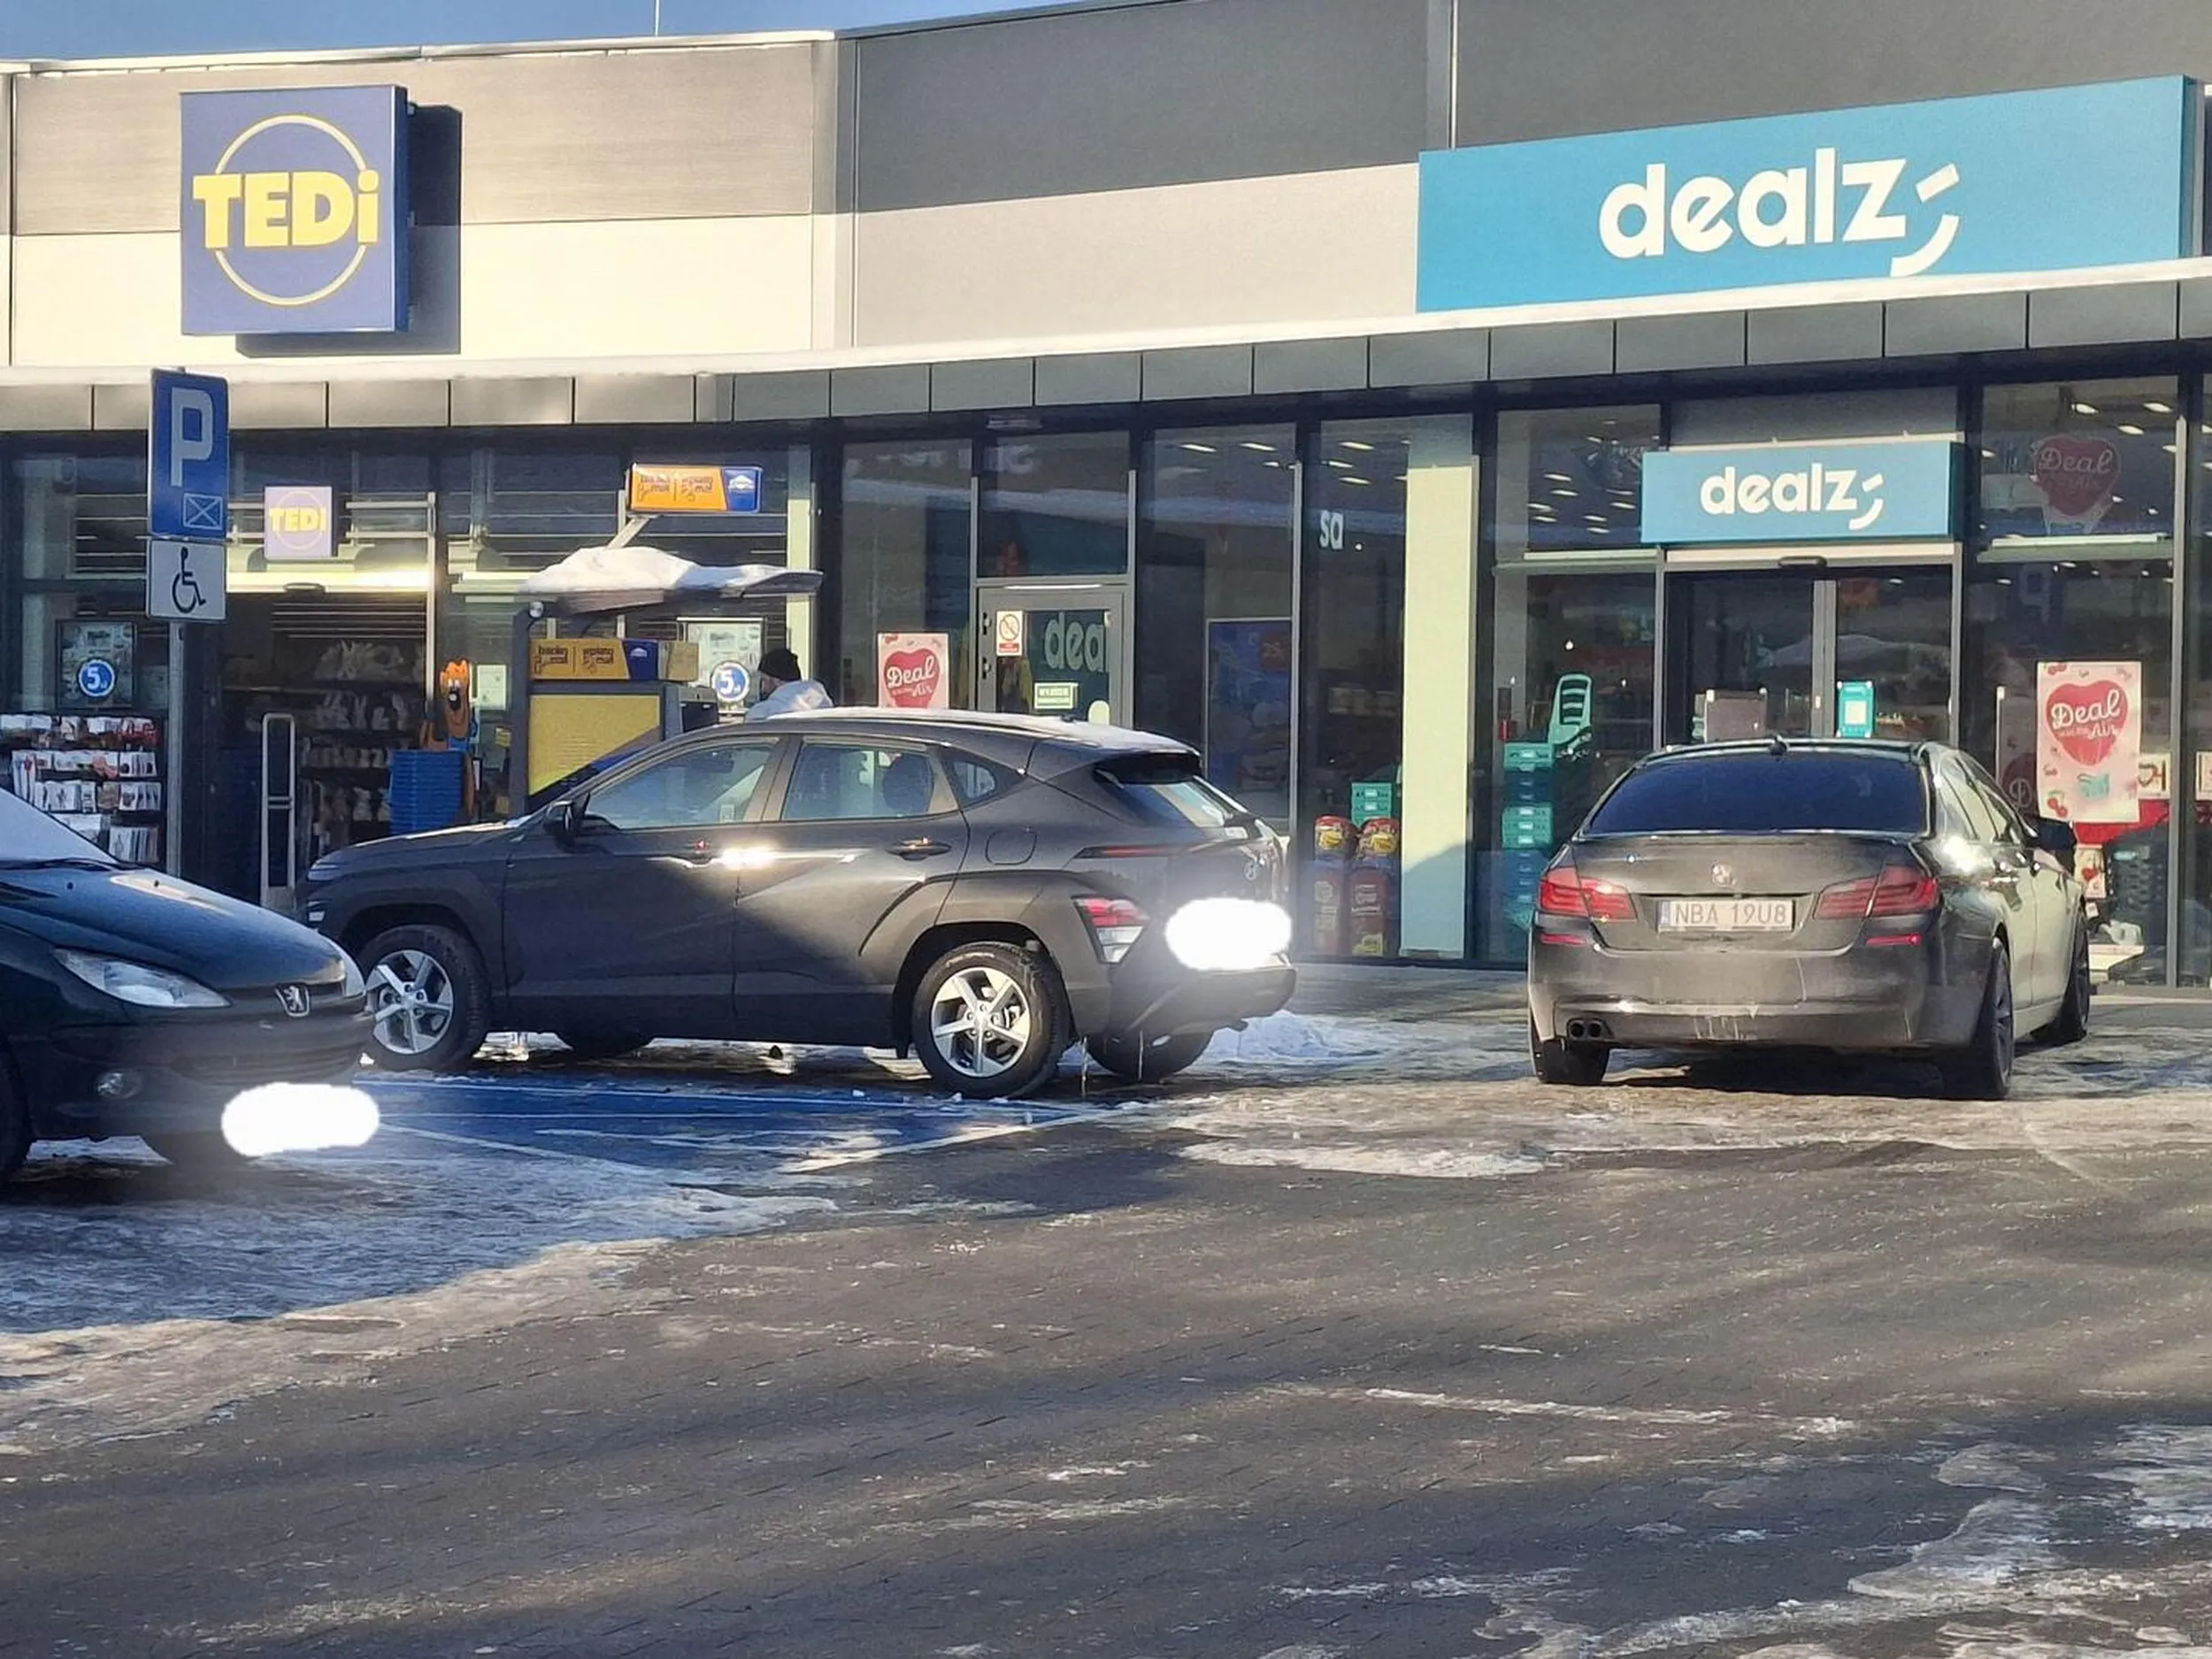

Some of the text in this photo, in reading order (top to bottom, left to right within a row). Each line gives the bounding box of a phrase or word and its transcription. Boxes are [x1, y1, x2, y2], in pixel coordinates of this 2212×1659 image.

[192, 169, 380, 249] TEDi
[1598, 147, 1907, 259] dealz
[170, 387, 213, 488] P
[2038, 447, 2114, 475] Deal
[1700, 462, 1858, 515] dealz
[887, 655, 935, 688] Deal
[2051, 688, 2121, 729] Deal
[1675, 902, 1719, 925] NBA
